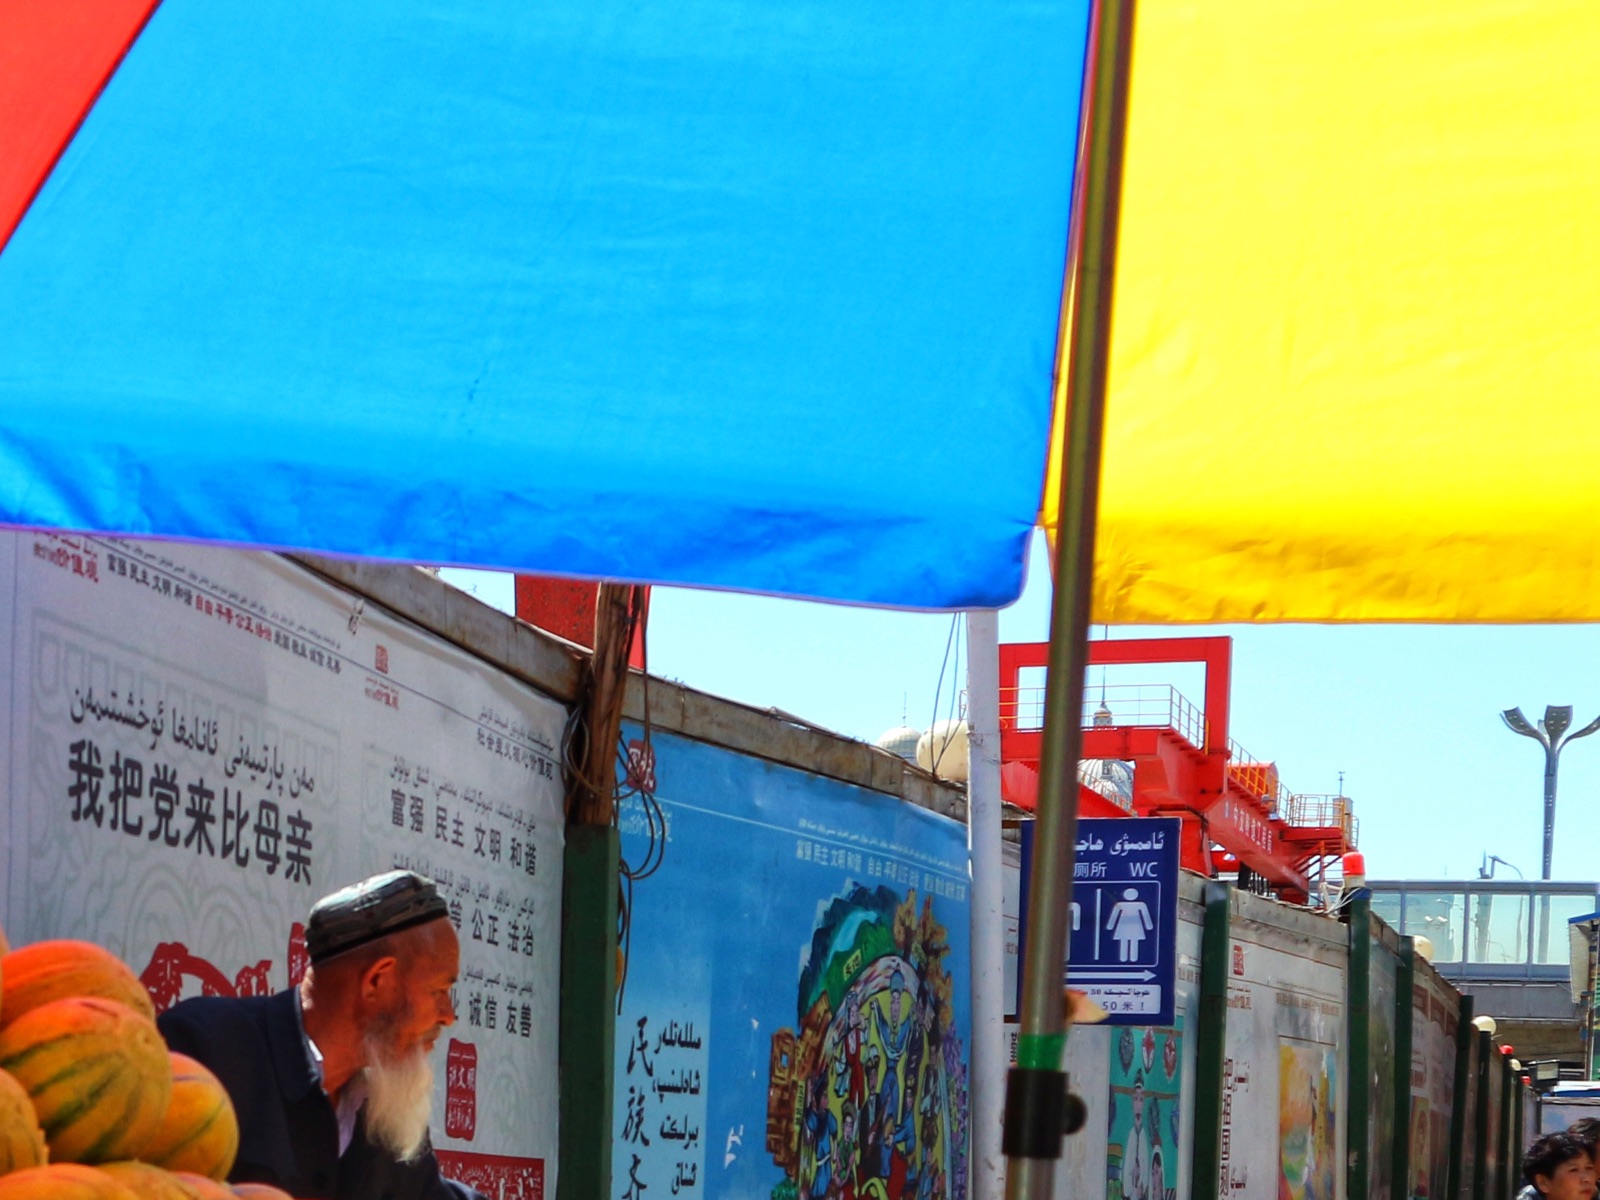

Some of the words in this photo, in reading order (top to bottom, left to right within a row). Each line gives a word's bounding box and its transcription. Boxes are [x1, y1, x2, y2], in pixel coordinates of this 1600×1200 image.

[171, 707, 219, 756] ئانامغا
[289, 766, 316, 799] مەن
[67, 738, 314, 886] 我把党来比母亲
[390, 787, 424, 834] 富强
[434, 804, 465, 848] 民主
[473, 821, 502, 863] 文明
[509, 836, 537, 876] 和谐
[1129, 861, 1159, 878] WC
[471, 907, 499, 947] 公正
[507, 918, 535, 957] 法治
[468, 991, 498, 1030] 诚信
[505, 1000, 533, 1038] 友善
[1102, 1001, 1118, 1011] 50
[653, 1019, 702, 1055] مىللەتلەر
[671, 1161, 698, 1196] ئىناق
